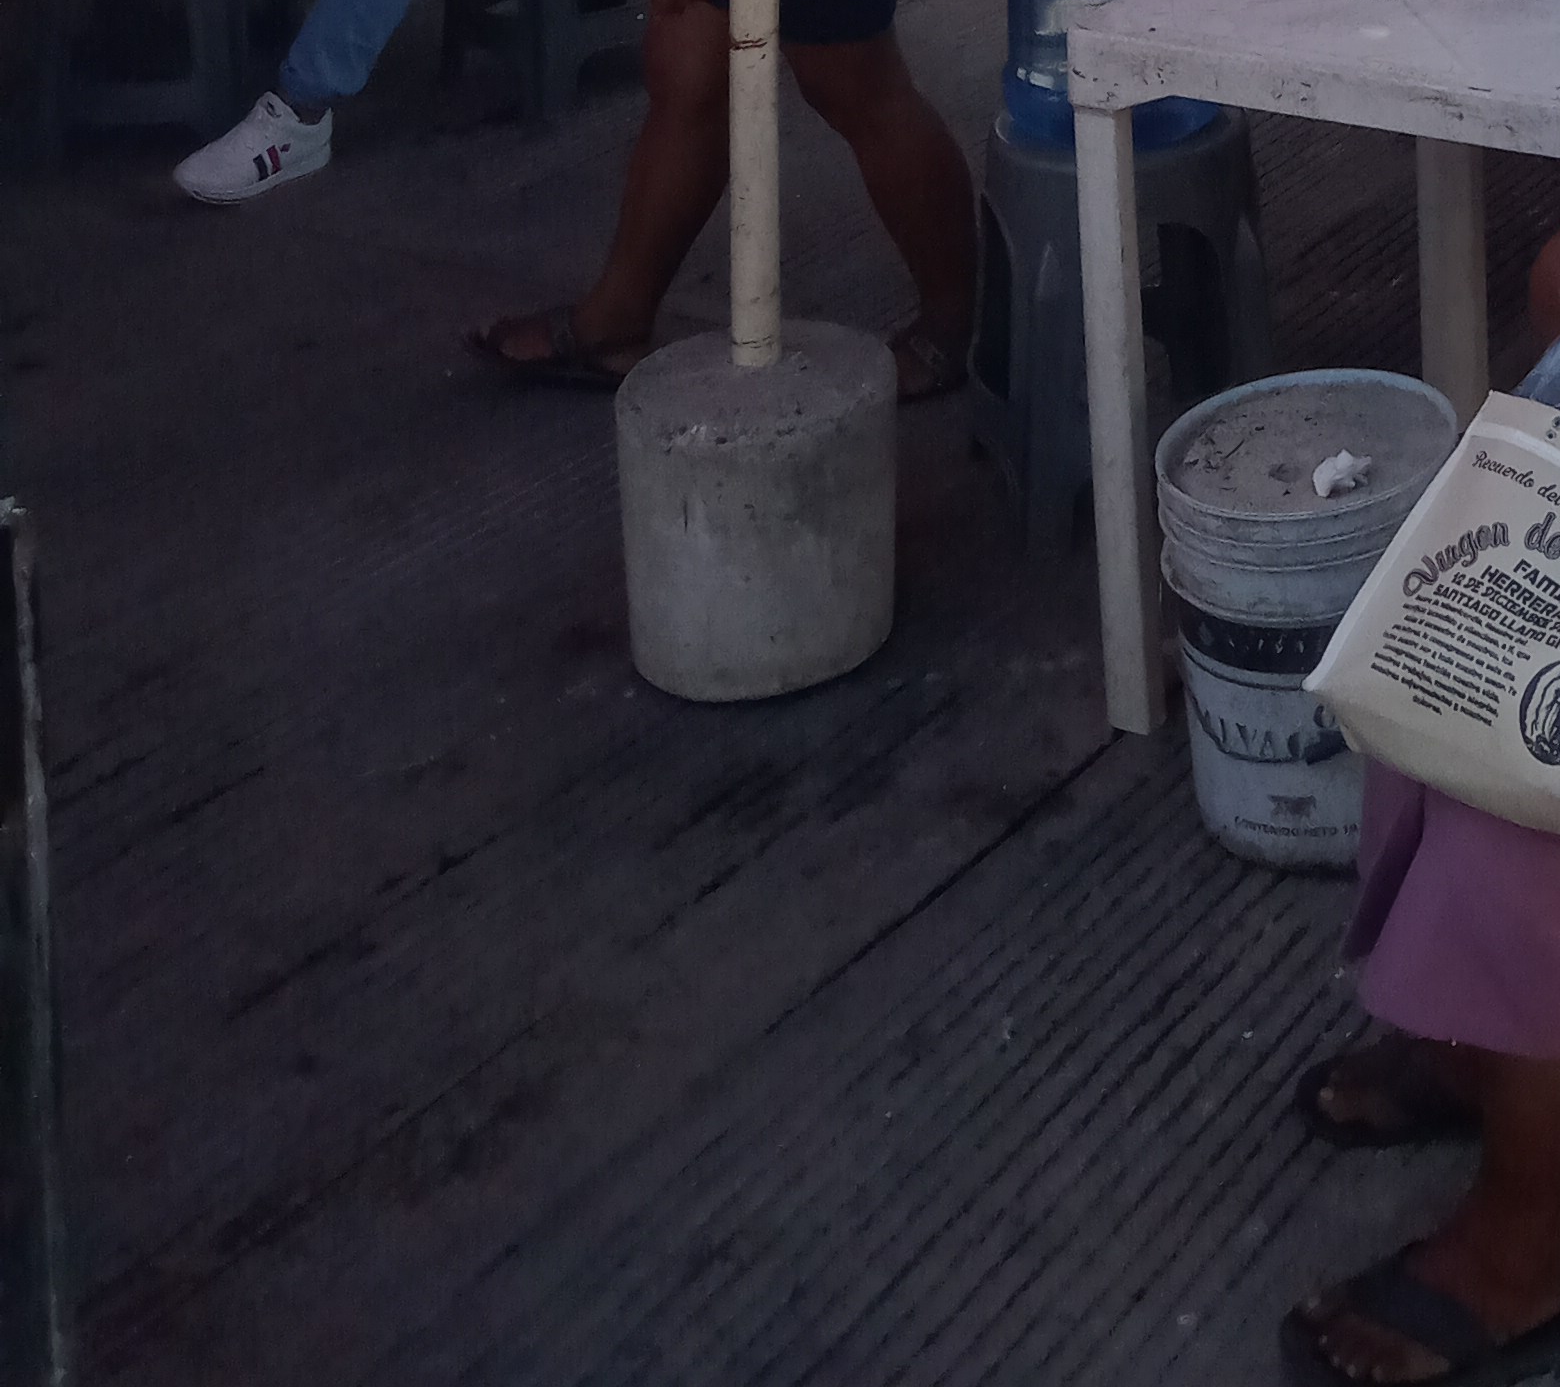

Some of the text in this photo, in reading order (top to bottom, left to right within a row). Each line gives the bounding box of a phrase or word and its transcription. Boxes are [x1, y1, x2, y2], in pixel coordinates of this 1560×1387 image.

[1471, 449, 1535, 490] Recuerdo
[1432, 583, 1501, 624] SANTIAGO
[1498, 613, 1547, 645] LLANO
[1462, 575, 1482, 593] DE
[1480, 583, 1553, 630] DICIEMBRE
